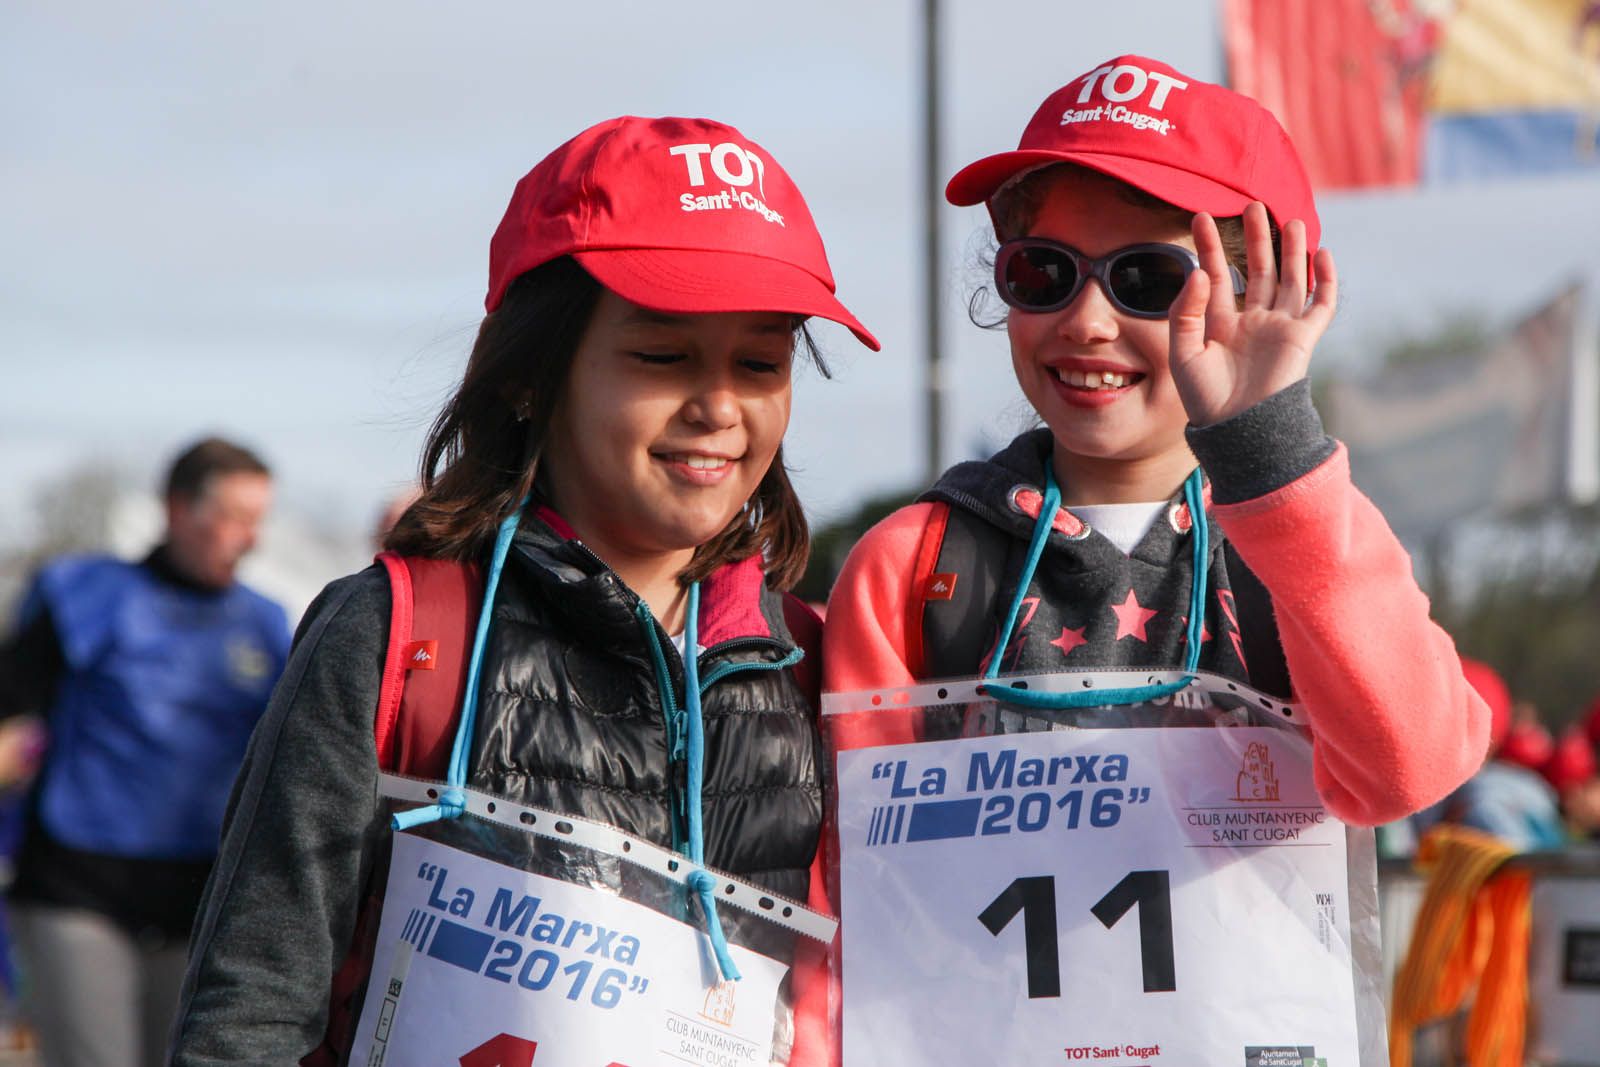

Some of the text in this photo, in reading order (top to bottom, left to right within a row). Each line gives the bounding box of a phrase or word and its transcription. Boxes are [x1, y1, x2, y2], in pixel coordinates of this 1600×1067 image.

[1077, 64, 1188, 111] TOT
[1060, 105, 1171, 135] Sant Cugat
[679, 190, 732, 211] Sant
[966, 749, 1129, 792] Marxa
[1187, 811, 1325, 826] CLUB MUNTANYENC
[1212, 828, 1300, 842] SANT CUGAT
[484, 887, 641, 966] Marxa
[976, 869, 1177, 999] 11
[666, 1017, 758, 1062] CLUB MUNTANYENC
[1064, 1044, 1160, 1060] TOT Sant Cugat
[679, 1041, 739, 1067] SANT CUGAT
[1261, 1049, 1300, 1059] Ajuntament
